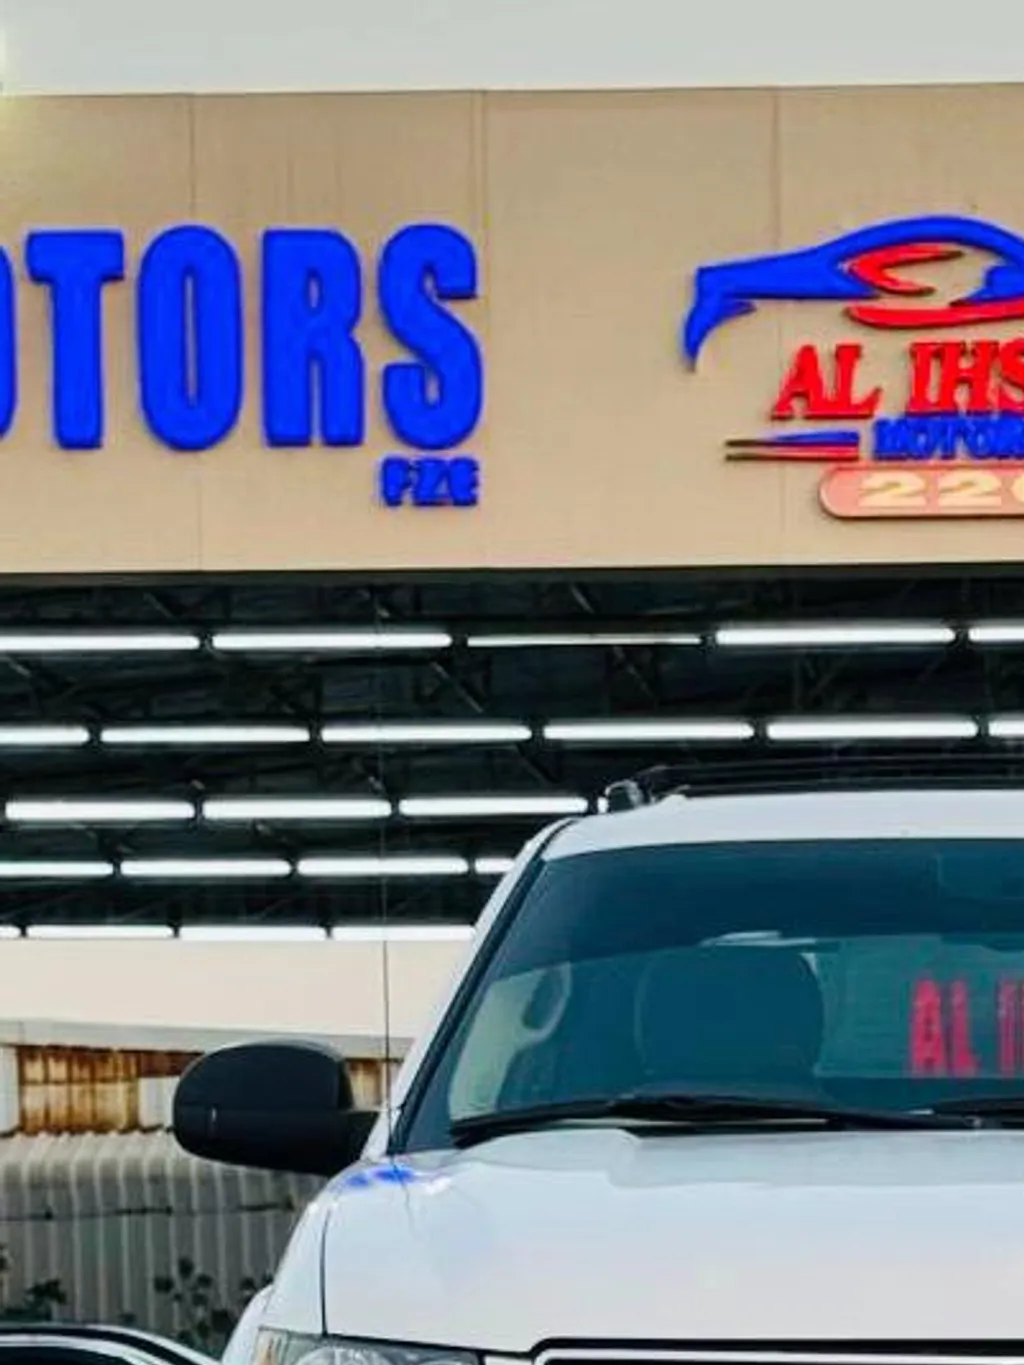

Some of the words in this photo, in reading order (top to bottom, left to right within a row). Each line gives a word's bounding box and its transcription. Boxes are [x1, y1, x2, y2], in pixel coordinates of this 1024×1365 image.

[0, 223, 484, 451] TORS
[771, 343, 883, 421] AL
[379, 457, 479, 507] FZE
[911, 976, 980, 1078] AL
